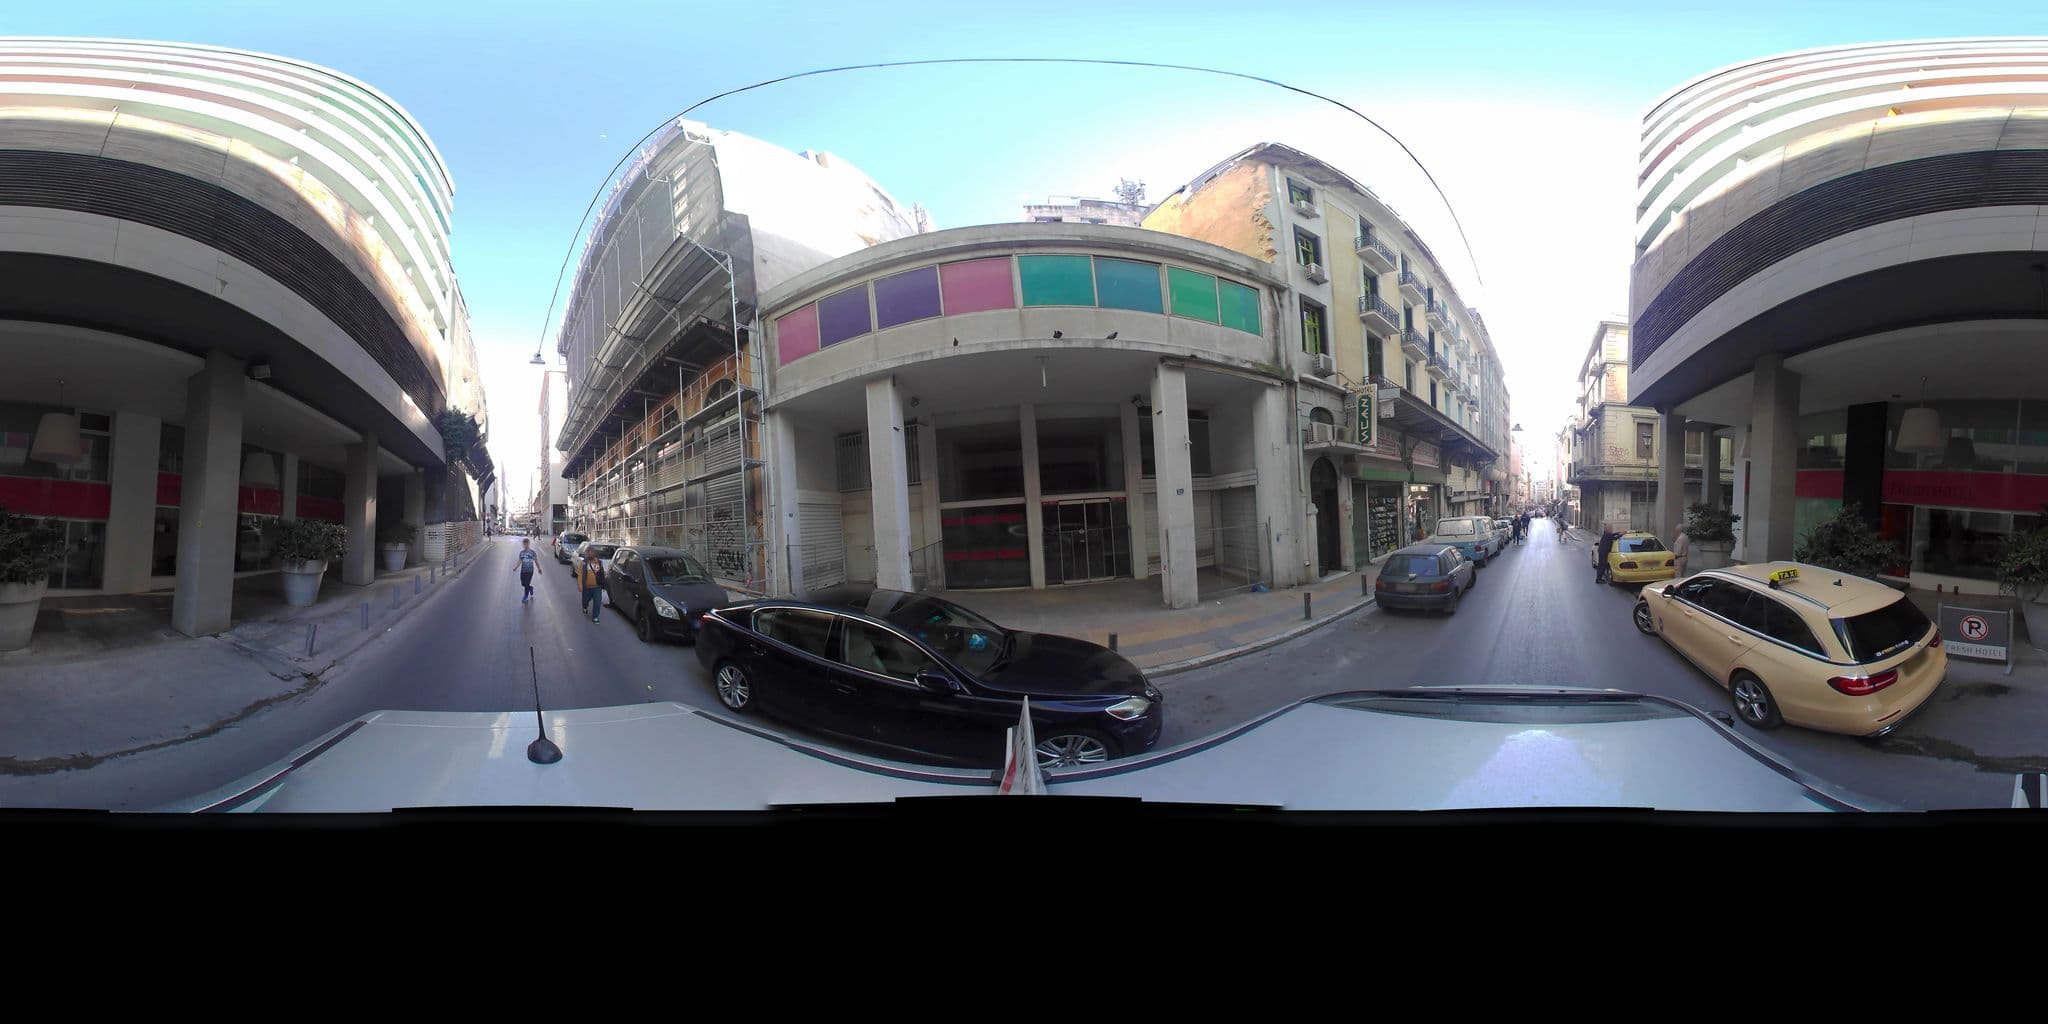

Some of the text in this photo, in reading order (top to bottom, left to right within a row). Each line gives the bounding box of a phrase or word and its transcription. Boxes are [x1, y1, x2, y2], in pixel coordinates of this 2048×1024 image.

[1360, 398, 1369, 442] ZEUS
[1778, 569, 1798, 579] TAXI
[1975, 647, 2002, 657] HOTEL
